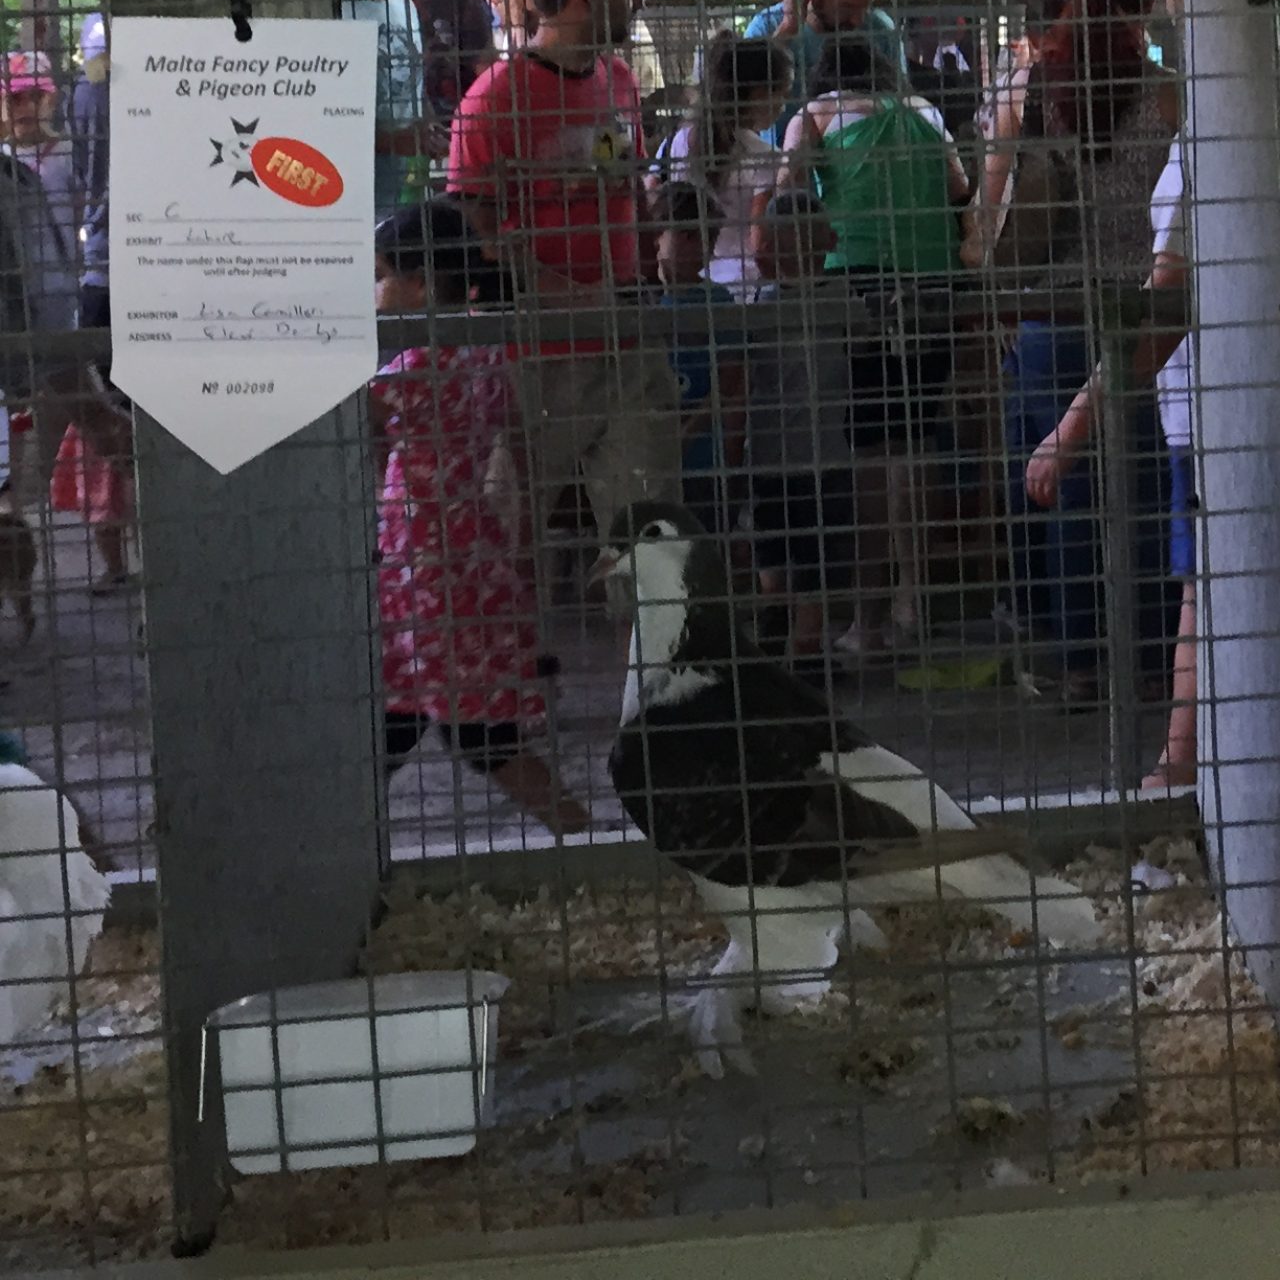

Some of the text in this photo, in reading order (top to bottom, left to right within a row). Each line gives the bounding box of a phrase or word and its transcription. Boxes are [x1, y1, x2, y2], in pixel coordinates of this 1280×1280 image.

[145, 55, 349, 77] Malta Fancy Poultry
[175, 78, 317, 100] & Pigeon Club
[127, 108, 151, 117] YEAR
[323, 107, 365, 117] PLACING
[266, 149, 328, 197] FIRST
[165, 201, 180, 220] C
[126, 237, 163, 247] EXHIBIT
[138, 256, 154, 266] The
[157, 257, 183, 266] name
[186, 256, 212, 266] under
[215, 256, 233, 266] this
[282, 256, 298, 266] not
[300, 256, 311, 266] be
[314, 256, 354, 267] exposed
[228, 267, 250, 276] after
[252, 267, 287, 278] judging
[127, 311, 178, 320] EXHIBITOR
[129, 333, 172, 342] ADDRESS
